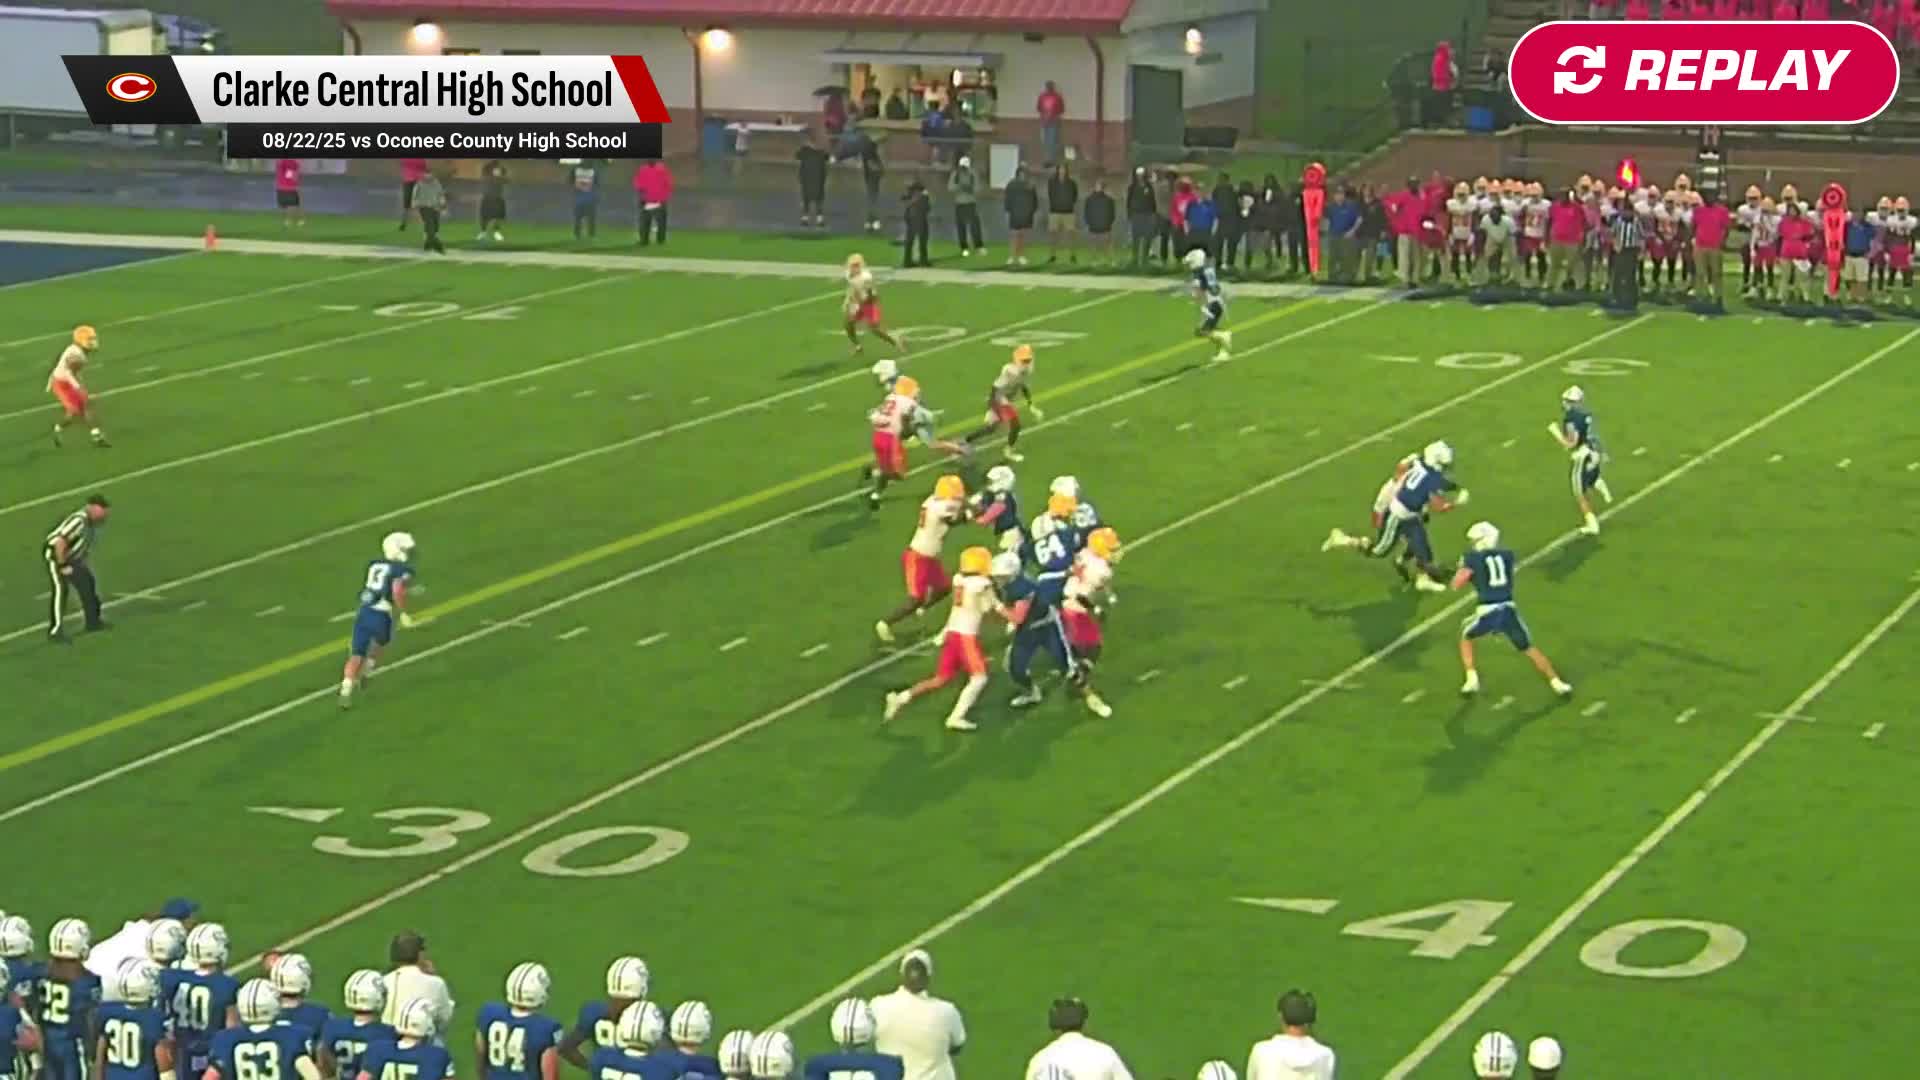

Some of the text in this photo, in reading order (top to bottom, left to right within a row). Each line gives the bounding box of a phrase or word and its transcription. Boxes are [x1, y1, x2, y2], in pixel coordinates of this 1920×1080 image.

[1485, 554, 1508, 587] 11
[311, 806, 691, 877] 30
[1340, 899, 1748, 978] 40
[172, 982, 211, 1031] 40
[104, 1018, 141, 1068] 30
[233, 1041, 282, 1080] 63
[488, 1020, 526, 1072] 84
